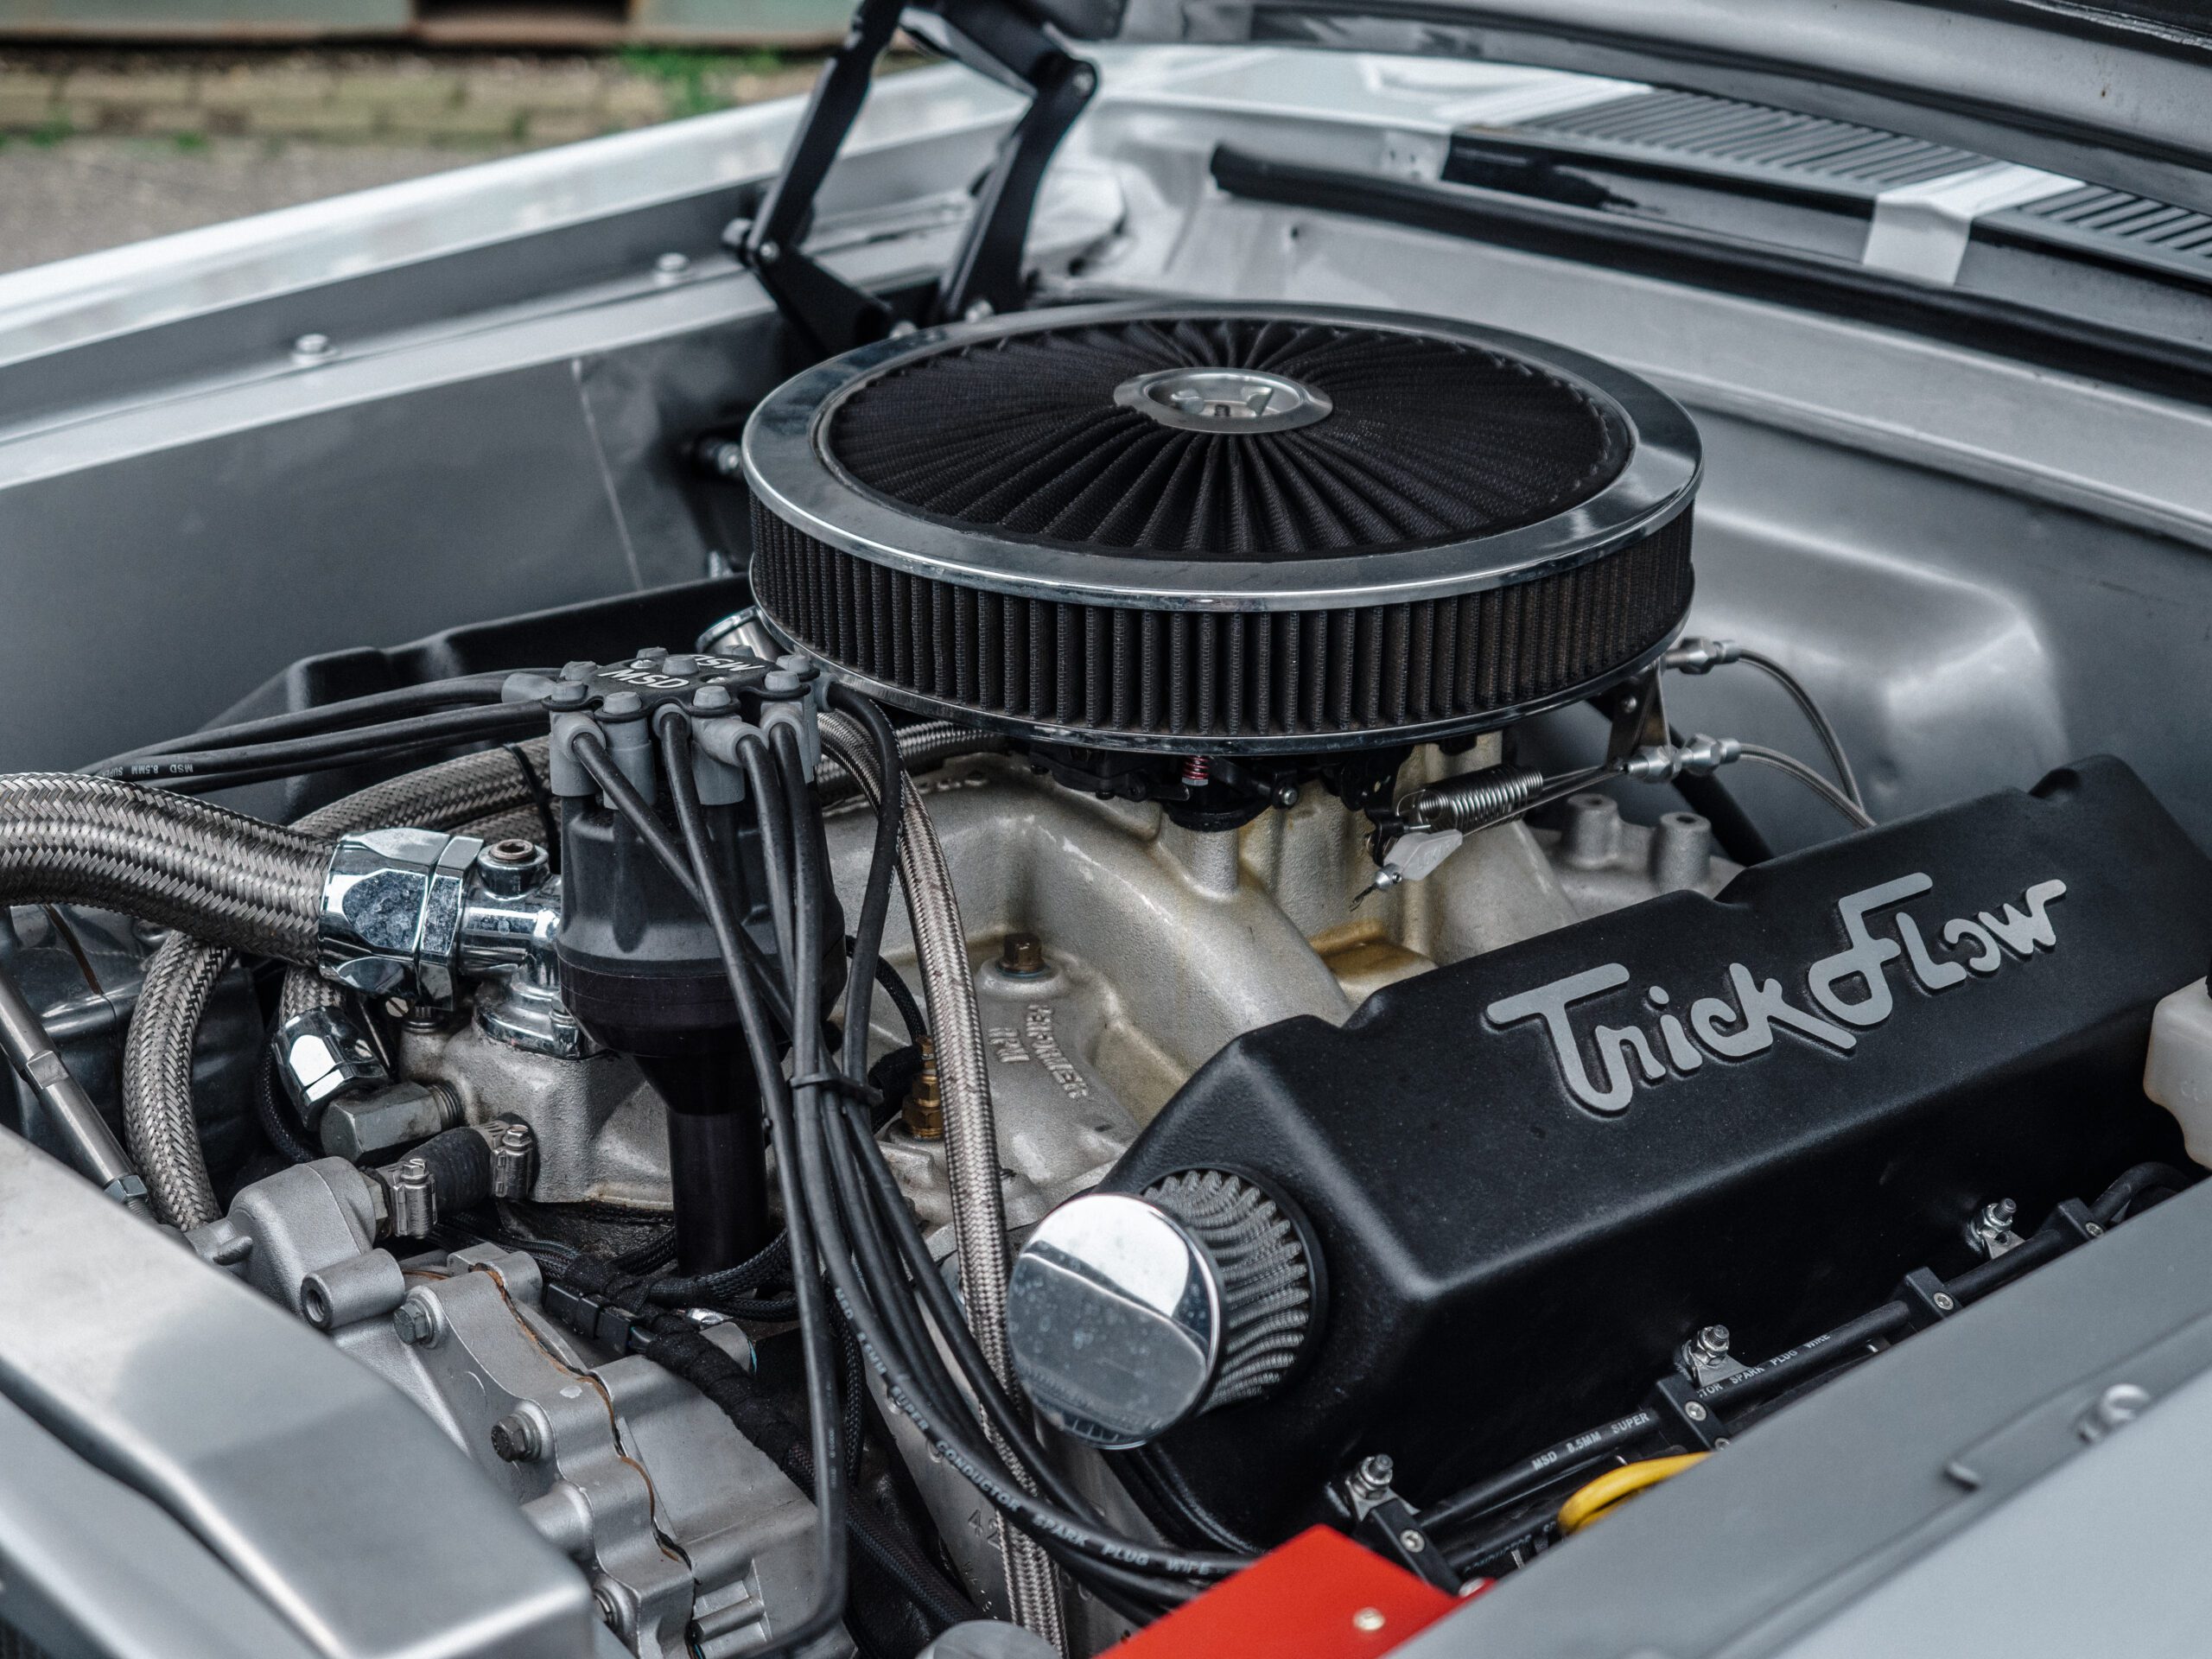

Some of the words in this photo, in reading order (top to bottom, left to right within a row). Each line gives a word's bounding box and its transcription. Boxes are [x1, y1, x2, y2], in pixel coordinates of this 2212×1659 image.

[597, 668, 690, 689] MSD
[131, 764, 159, 775] 8.5MM
[169, 763, 194, 773] MSD
[1486, 962, 1858, 1112] Trick
[1531, 1451, 1558, 1471] MSD
[1566, 1431, 1603, 1453] 8.5MM
[1611, 1412, 1651, 1434] SUPER
[1729, 1365, 1766, 1384] SPARK
[1770, 1349, 1799, 1366] PLUG
[890, 1385, 930, 1431] SUPER
[936, 1440, 1024, 1512] CONDUCTOR
[1033, 1513, 1089, 1548] SPARK
[1101, 1541, 1151, 1567] PLUG
